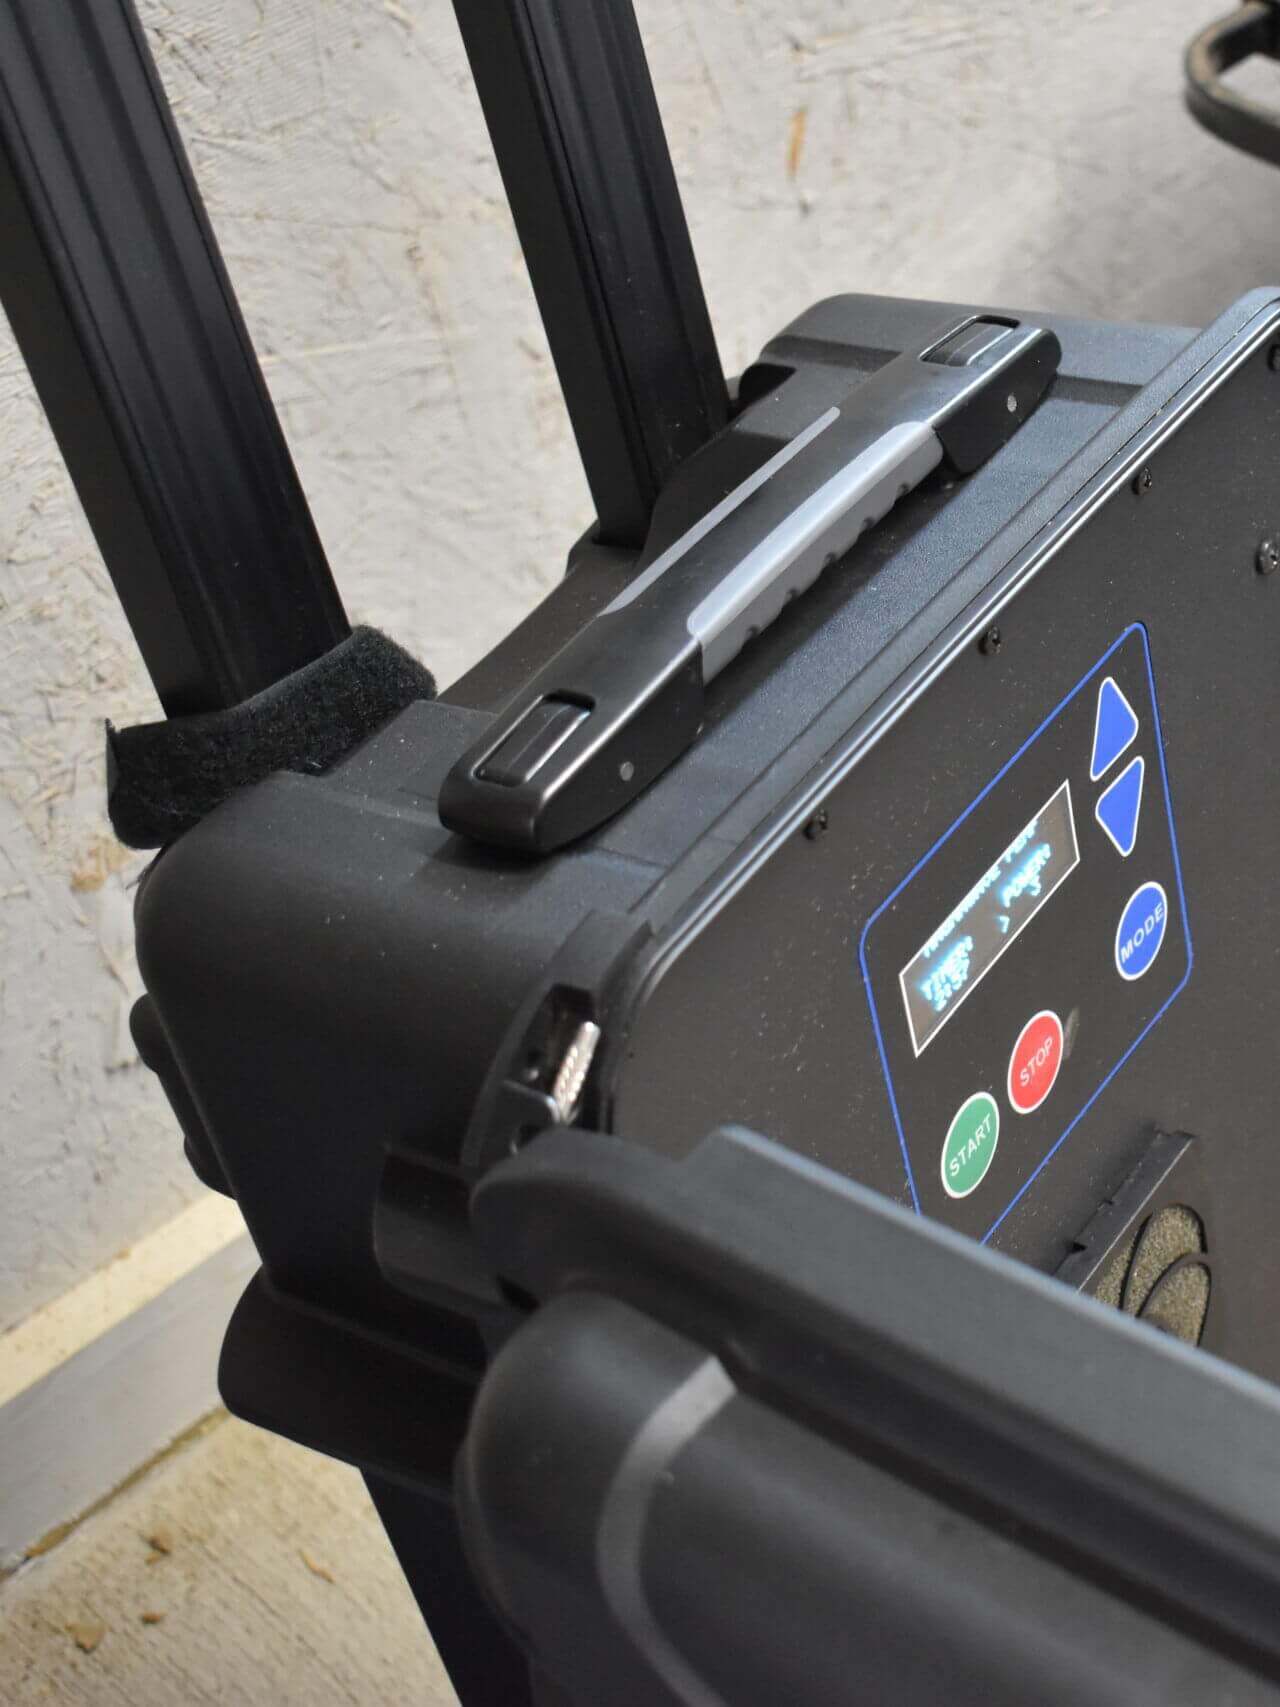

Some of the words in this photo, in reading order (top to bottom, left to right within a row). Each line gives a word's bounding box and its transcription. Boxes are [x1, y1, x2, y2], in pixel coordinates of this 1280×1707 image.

[1120, 902, 1164, 964] MODE
[1019, 1036, 1054, 1087] STOP
[949, 1113, 993, 1177] START
